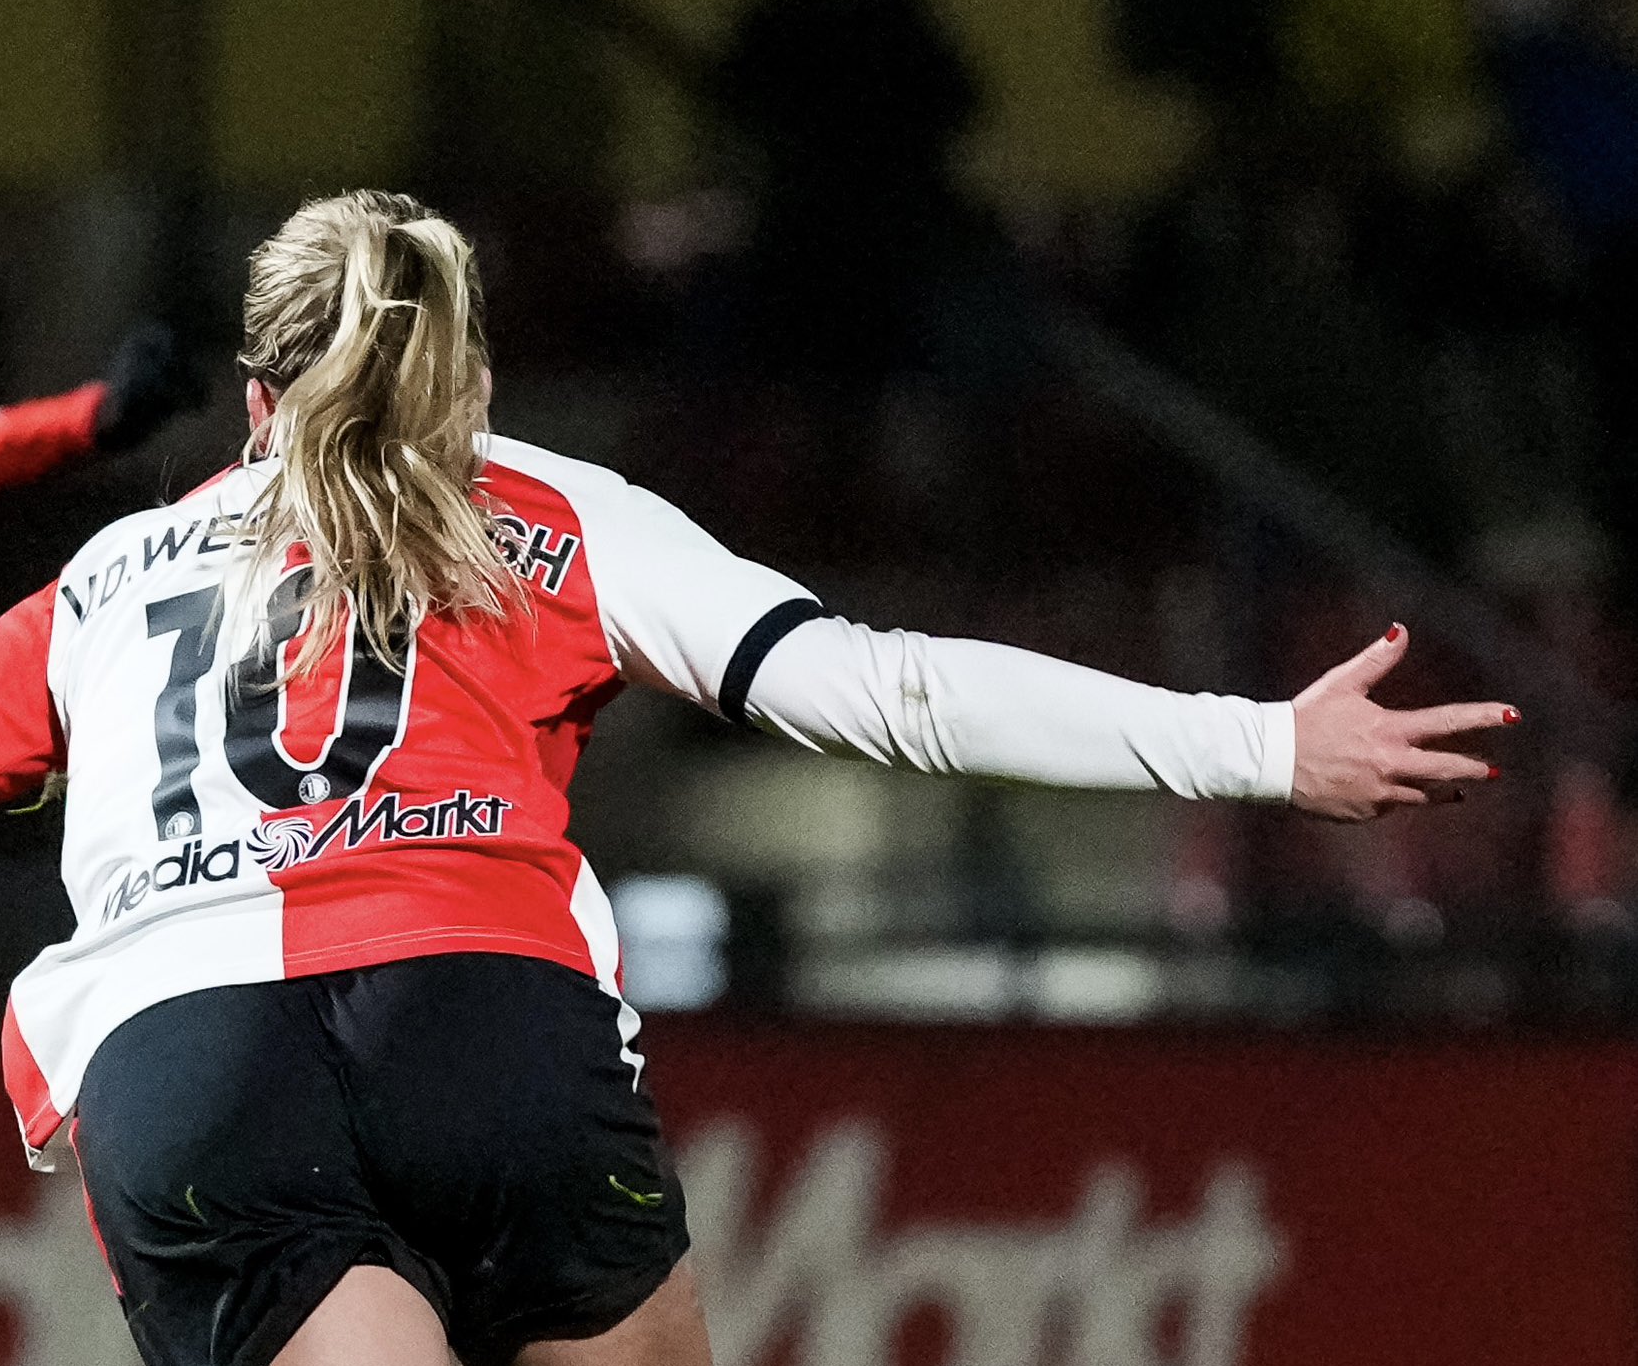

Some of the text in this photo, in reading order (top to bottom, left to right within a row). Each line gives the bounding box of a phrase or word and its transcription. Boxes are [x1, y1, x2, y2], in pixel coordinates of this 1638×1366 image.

[146, 557, 418, 841] 10
[98, 790, 513, 931] Media Markt
